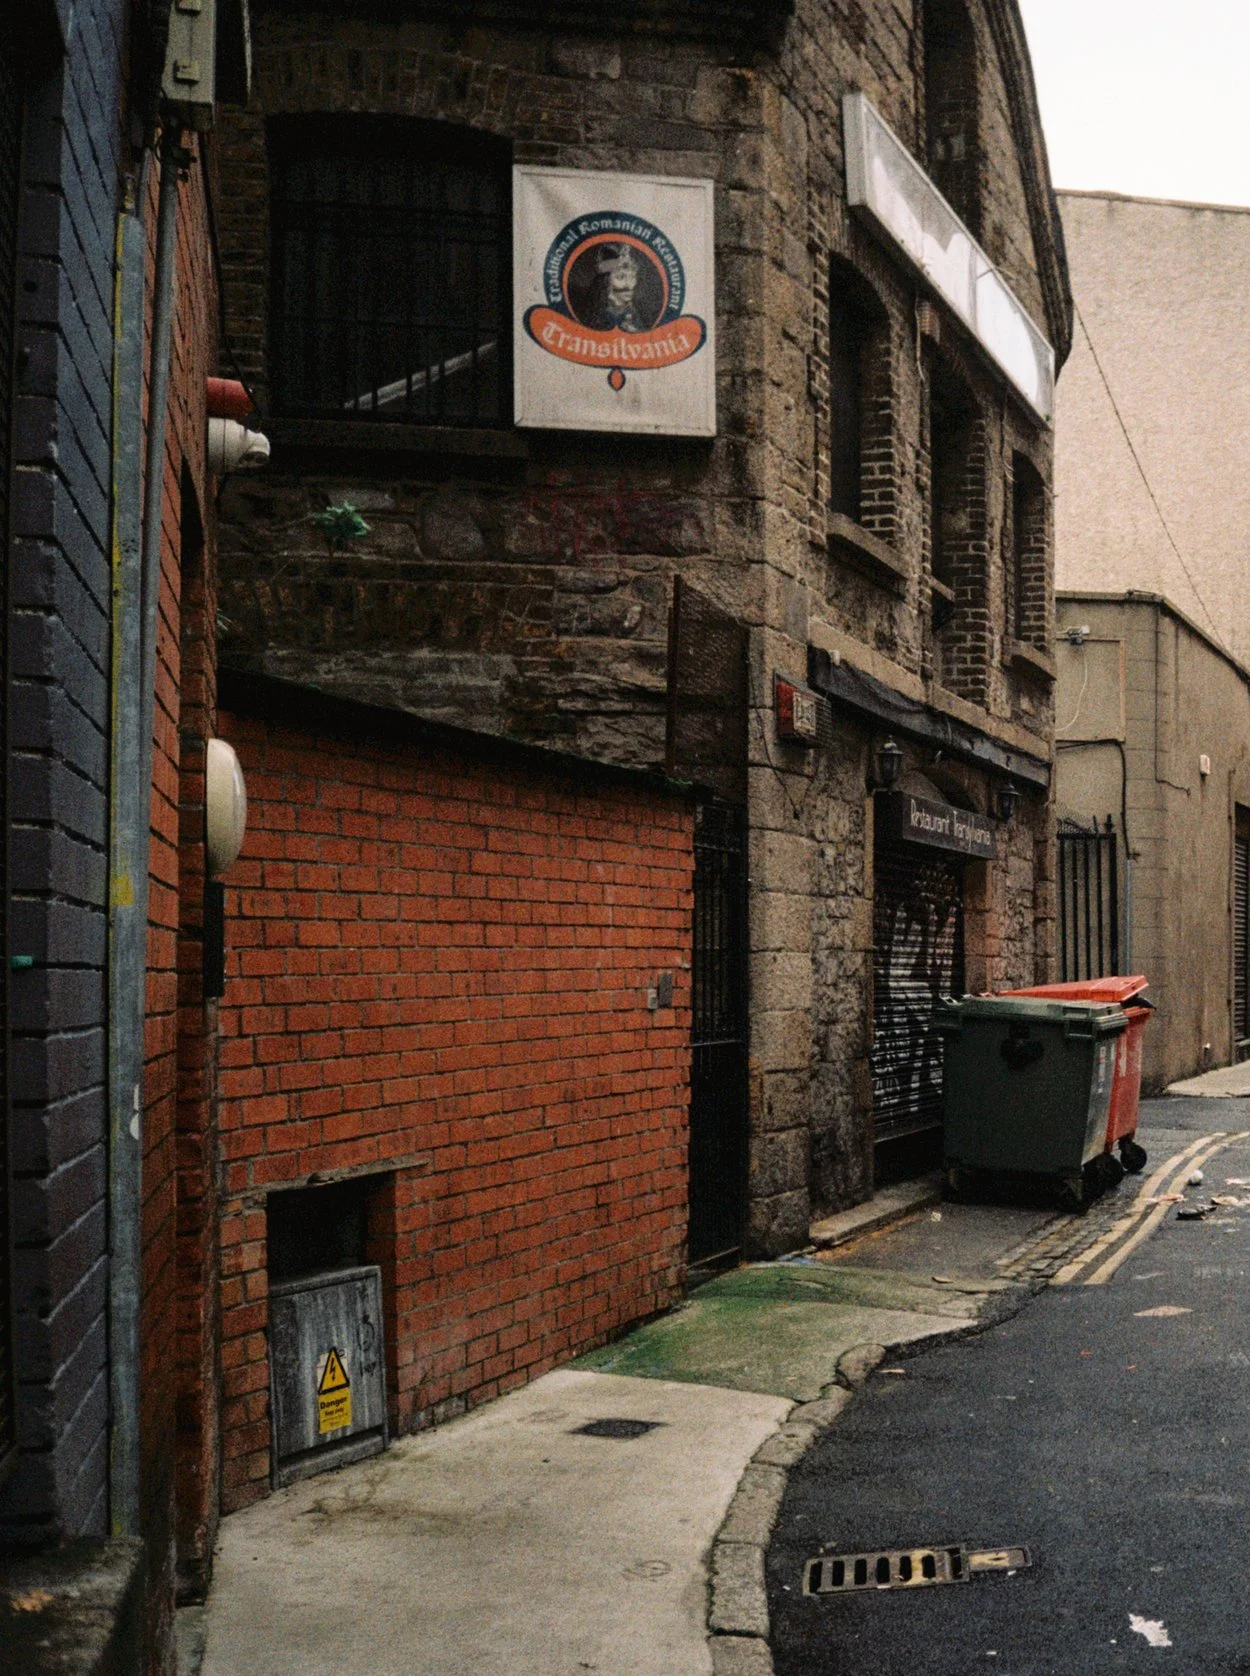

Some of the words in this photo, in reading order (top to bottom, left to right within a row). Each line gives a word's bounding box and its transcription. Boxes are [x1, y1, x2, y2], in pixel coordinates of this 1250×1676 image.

[548, 230, 579, 302] Traditional
[579, 219, 653, 240] Romanian
[652, 236, 682, 310] Restaurant
[542, 320, 691, 360] Transilvania
[911, 799, 950, 834] Restaurant
[320, 1397, 347, 1409] Danger
